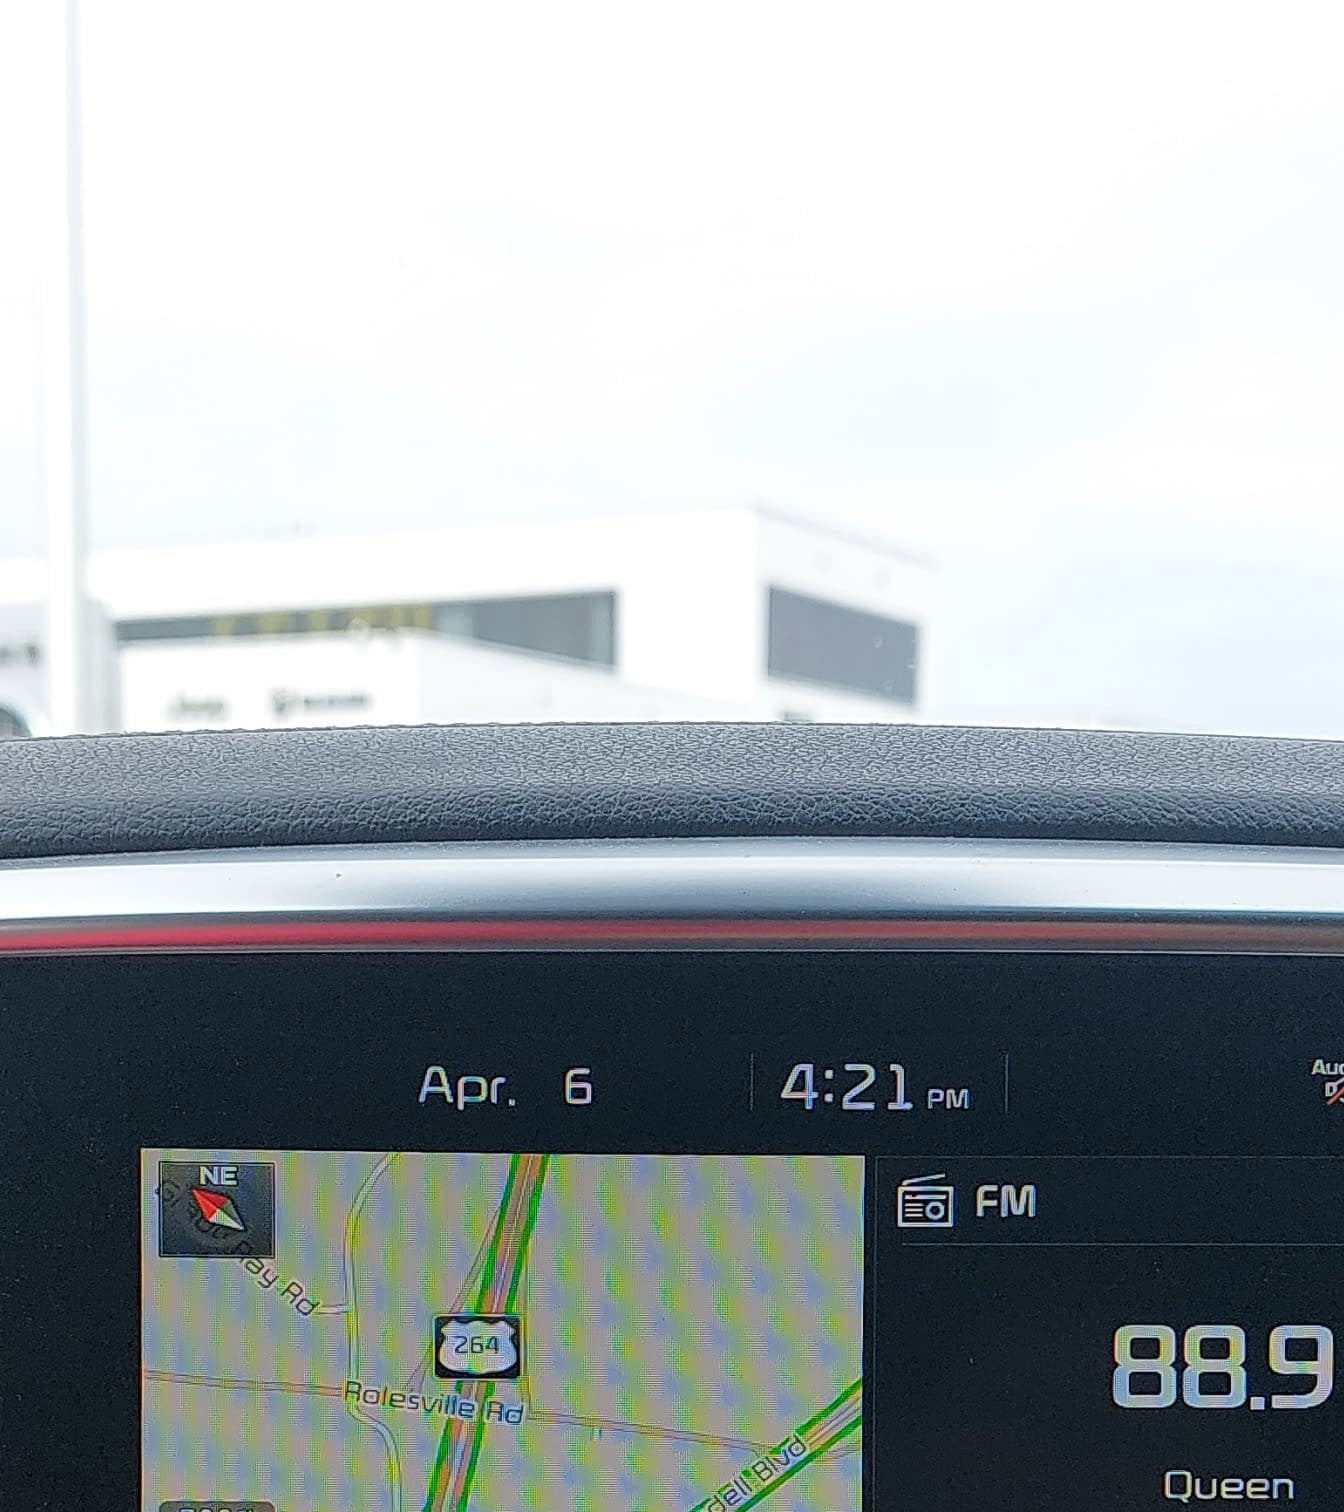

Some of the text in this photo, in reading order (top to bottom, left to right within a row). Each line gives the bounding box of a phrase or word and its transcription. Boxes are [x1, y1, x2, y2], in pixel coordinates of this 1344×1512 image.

[418, 1065, 592, 1111] Apr. 6
[780, 1063, 970, 1110] 4:21 PM
[198, 1164, 240, 1187] NE
[976, 1184, 1037, 1218] FM
[281, 1281, 320, 1316] Rd
[454, 1335, 499, 1355] 264
[1112, 1324, 1334, 1411] 88.9
[344, 1381, 524, 1424] Rolesville Rd
[752, 1434, 807, 1482] Blvd
[1164, 1470, 1294, 1503] Queen
